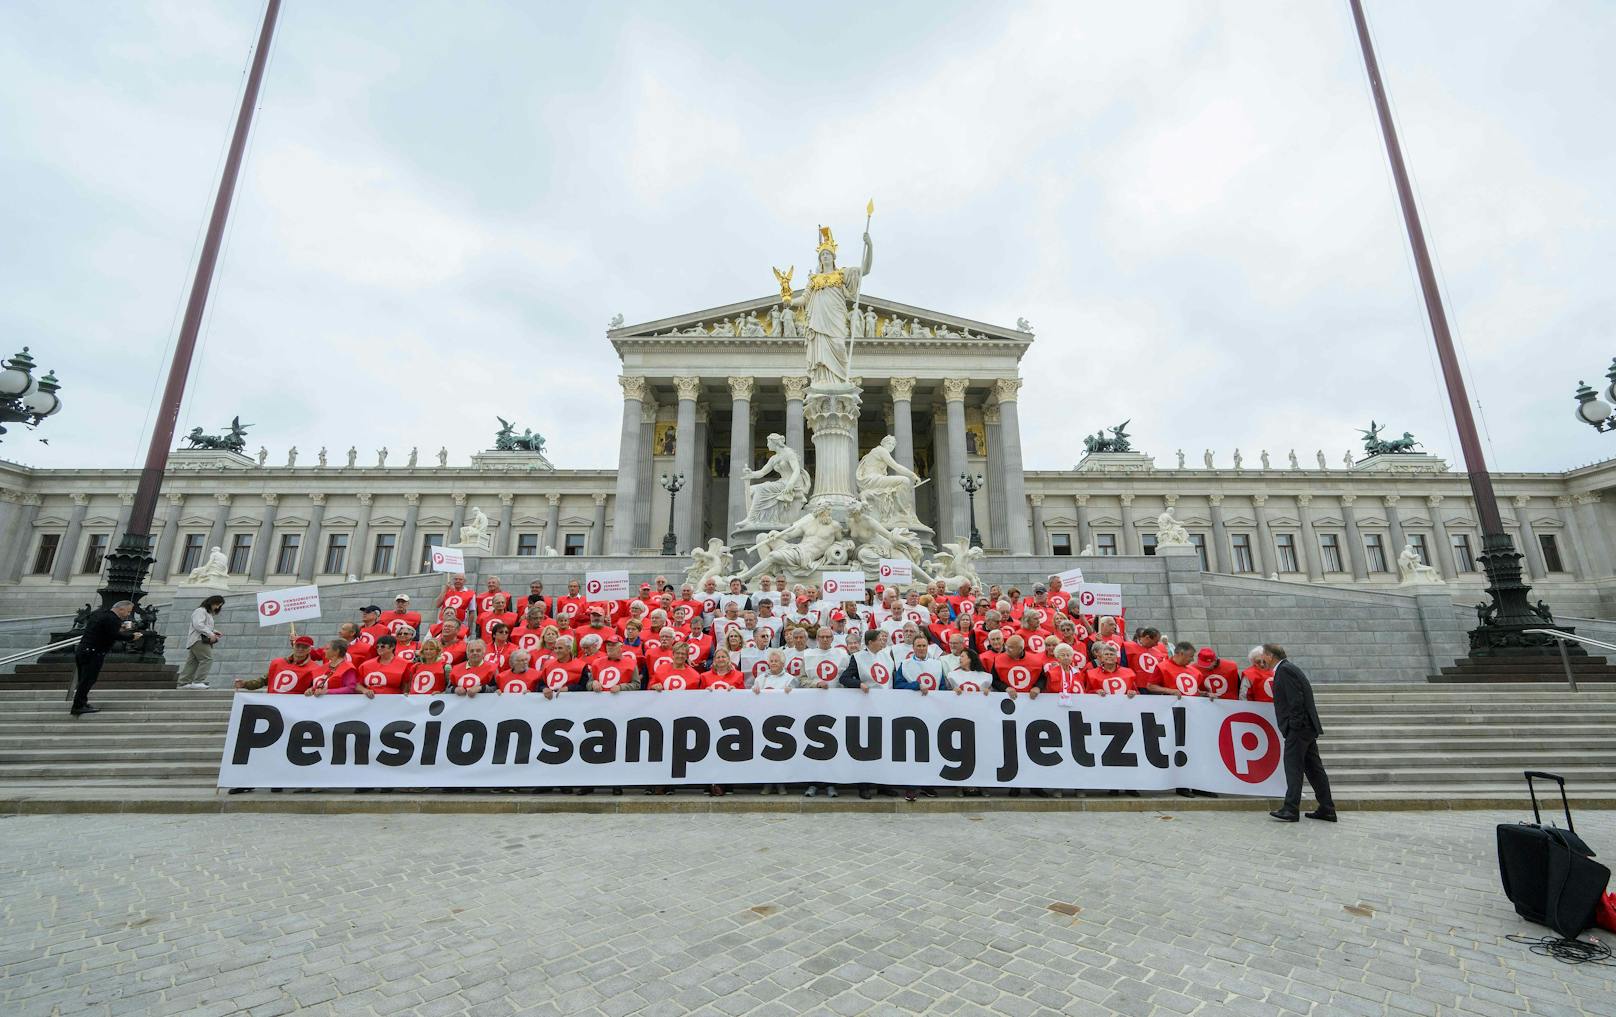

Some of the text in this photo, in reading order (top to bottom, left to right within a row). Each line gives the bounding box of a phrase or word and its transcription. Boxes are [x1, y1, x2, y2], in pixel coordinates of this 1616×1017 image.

[232, 699, 976, 781] Pensionsanpassung
[996, 698, 1188, 782] jetzt!
[1230, 721, 1269, 775] P
